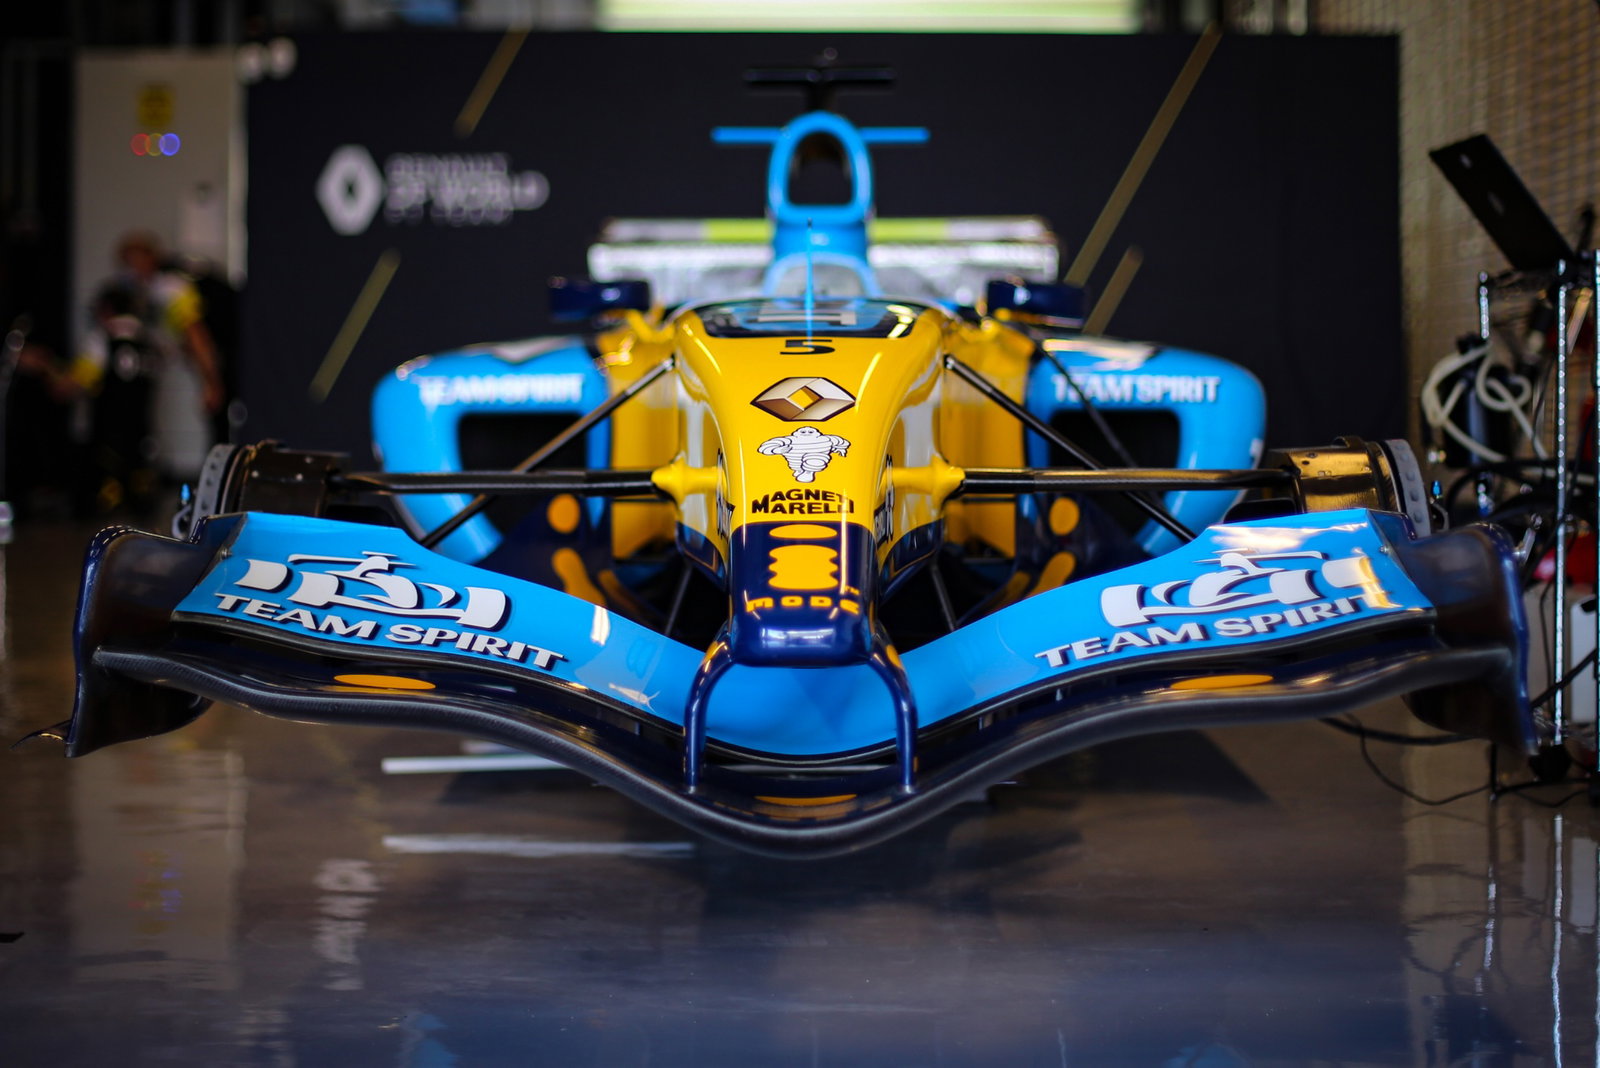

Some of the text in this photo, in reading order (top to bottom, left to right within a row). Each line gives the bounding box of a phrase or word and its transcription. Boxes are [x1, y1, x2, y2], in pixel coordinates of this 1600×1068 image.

[780, 339, 835, 355] 5
[1136, 375, 1220, 403] SPIRIT
[215, 593, 565, 669] TEAM SPIRIT
[1034, 590, 1385, 668] TEAM SPIRIT
